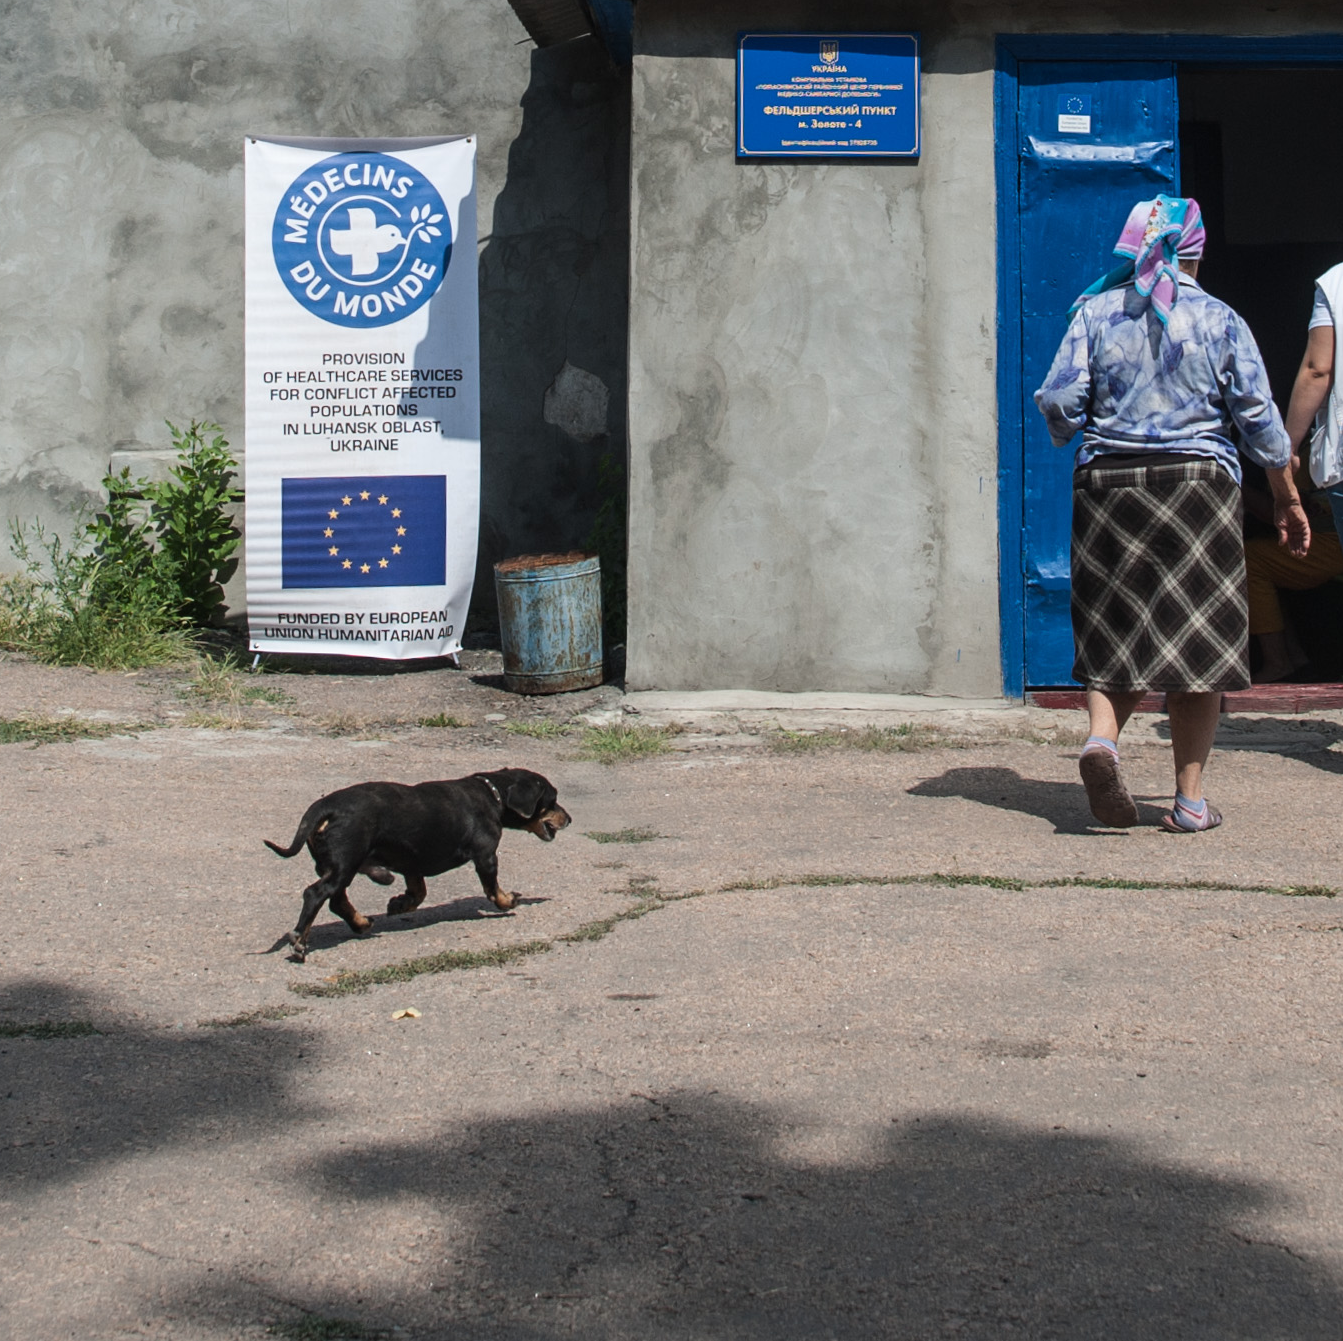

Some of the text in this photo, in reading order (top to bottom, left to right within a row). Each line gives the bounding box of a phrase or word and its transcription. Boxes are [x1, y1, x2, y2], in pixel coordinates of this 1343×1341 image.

[811, 63, 847, 73] УКРАЇНА
[763, 104, 897, 117] ФЕЛЬДШЕРСЬКИЙ ПУНКТ
[854, 119, 862, 129] 4
[284, 163, 414, 244] MÉDECINS
[289, 257, 437, 318] DU MONDE
[322, 352, 405, 366] PROVISION
[263, 369, 463, 384] OF HEALTHCARE SERVICES
[270, 386, 457, 401] FOR CONFLICT AFFECTED
[310, 403, 418, 417] POPULATIONS
[283, 420, 445, 435] IN LUHANSK OBLAST,
[330, 438, 399, 452] UKRAINE
[277, 610, 448, 625] FUNDED BY EUROPEAN
[264, 625, 454, 642] UNION HUMANITARIAN AID
